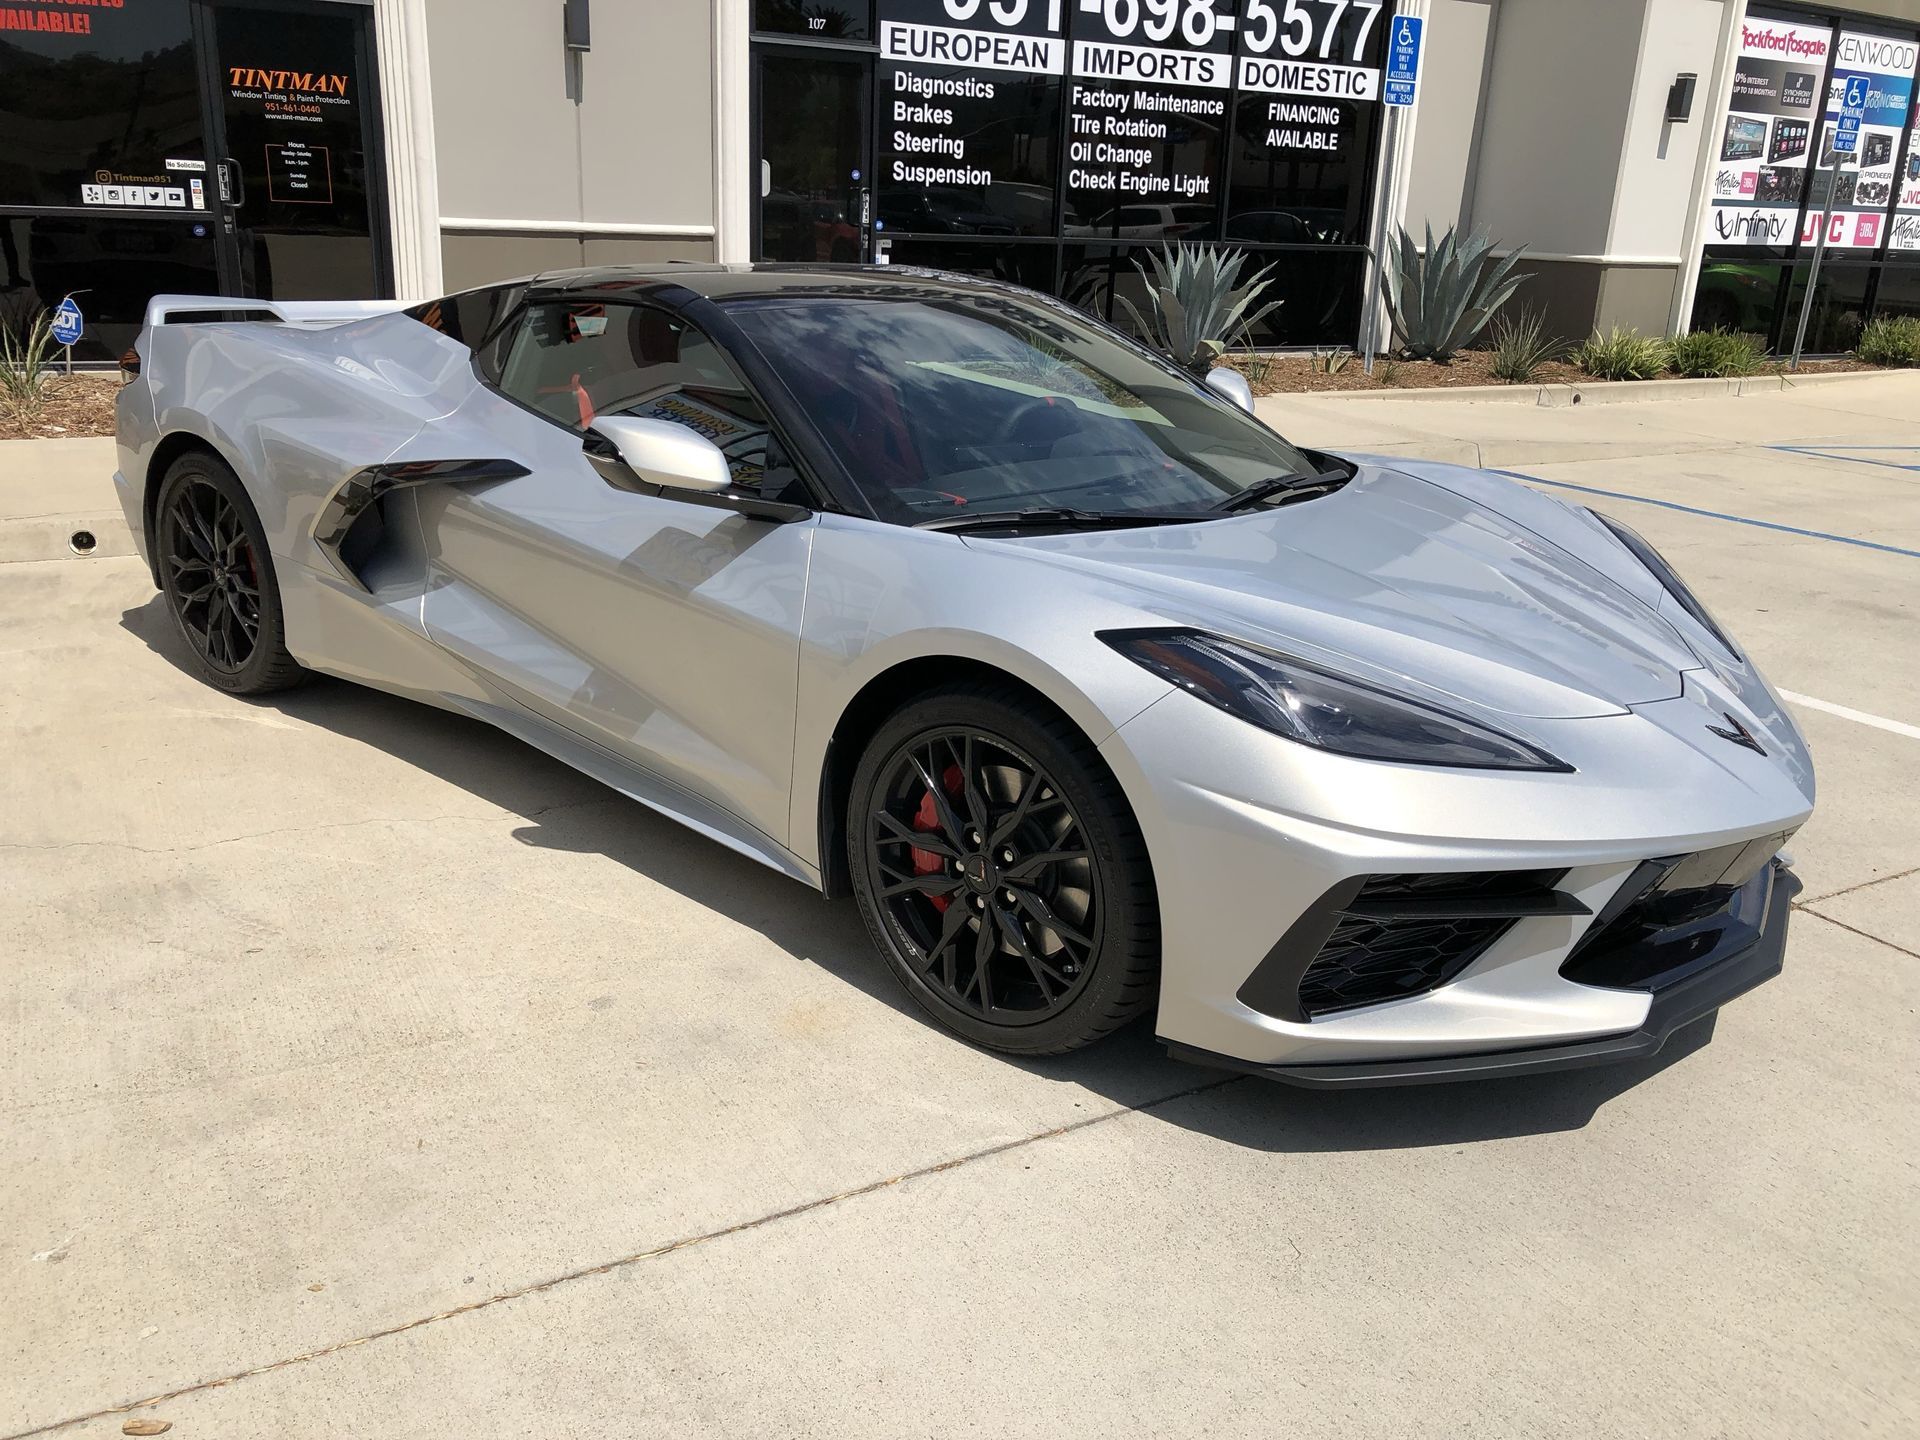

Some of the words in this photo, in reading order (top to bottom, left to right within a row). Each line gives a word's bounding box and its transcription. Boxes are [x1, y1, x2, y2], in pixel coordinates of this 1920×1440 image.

[808, 18, 826, 30] 107
[890, 26, 1049, 69] EUROPEAN
[1396, 45, 1414, 55] PARKING
[1837, 37, 1915, 70] KENWOOD
[1082, 46, 1215, 83] IMPORTS
[229, 67, 348, 97] TINTMAN
[894, 70, 995, 99] Diagnostics
[1245, 62, 1368, 96] DOMESTIC
[1390, 71, 1414, 80] ACCESSIBLE
[1735, 72, 1747, 84] 0%
[1747, 77, 1769, 86] INTEREST
[231, 90, 262, 99] Window
[264, 91, 287, 102] Tinting
[289, 93, 296, 101] &
[296, 94, 314, 103] Paint
[315, 96, 351, 105] Protection
[1386, 93, 1397, 102] FINE
[1390, 82, 1411, 92] MINIMUM
[1733, 85, 1740, 93] UP
[1740, 86, 1748, 94] TO
[1783, 88, 1812, 98] SYNCHRONY
[265, 102, 321, 114] 951-461-0440
[1072, 86, 1130, 114] Factory
[1133, 90, 1224, 115] Maintenance
[1782, 96, 1795, 104] CAR
[1795, 97, 1810, 105] CARE
[265, 113, 323, 123] www.tint-man.com
[893, 100, 953, 125] Brakes
[1268, 102, 1340, 125] FINANCING
[1841, 106, 1863, 118] PARKING
[1071, 114, 1101, 135] Tire
[1104, 115, 1167, 138] Rotation
[1842, 118, 1857, 130] ONLY
[893, 130, 965, 159] Steering
[1265, 128, 1339, 151] AVAILABLE
[1070, 142, 1092, 162] Oil
[1095, 143, 1152, 168] Change
[113, 173, 172, 183] Tintman951
[219, 166, 230, 199] PULL
[892, 160, 992, 188] Suspension
[1069, 169, 1116, 189] Check
[1120, 171, 1170, 195] Engine
[1174, 174, 1210, 197] Light
[1733, 208, 1788, 243] Infinity
[1860, 222, 1874, 238] JBL
[53, 310, 79, 330] ADT
